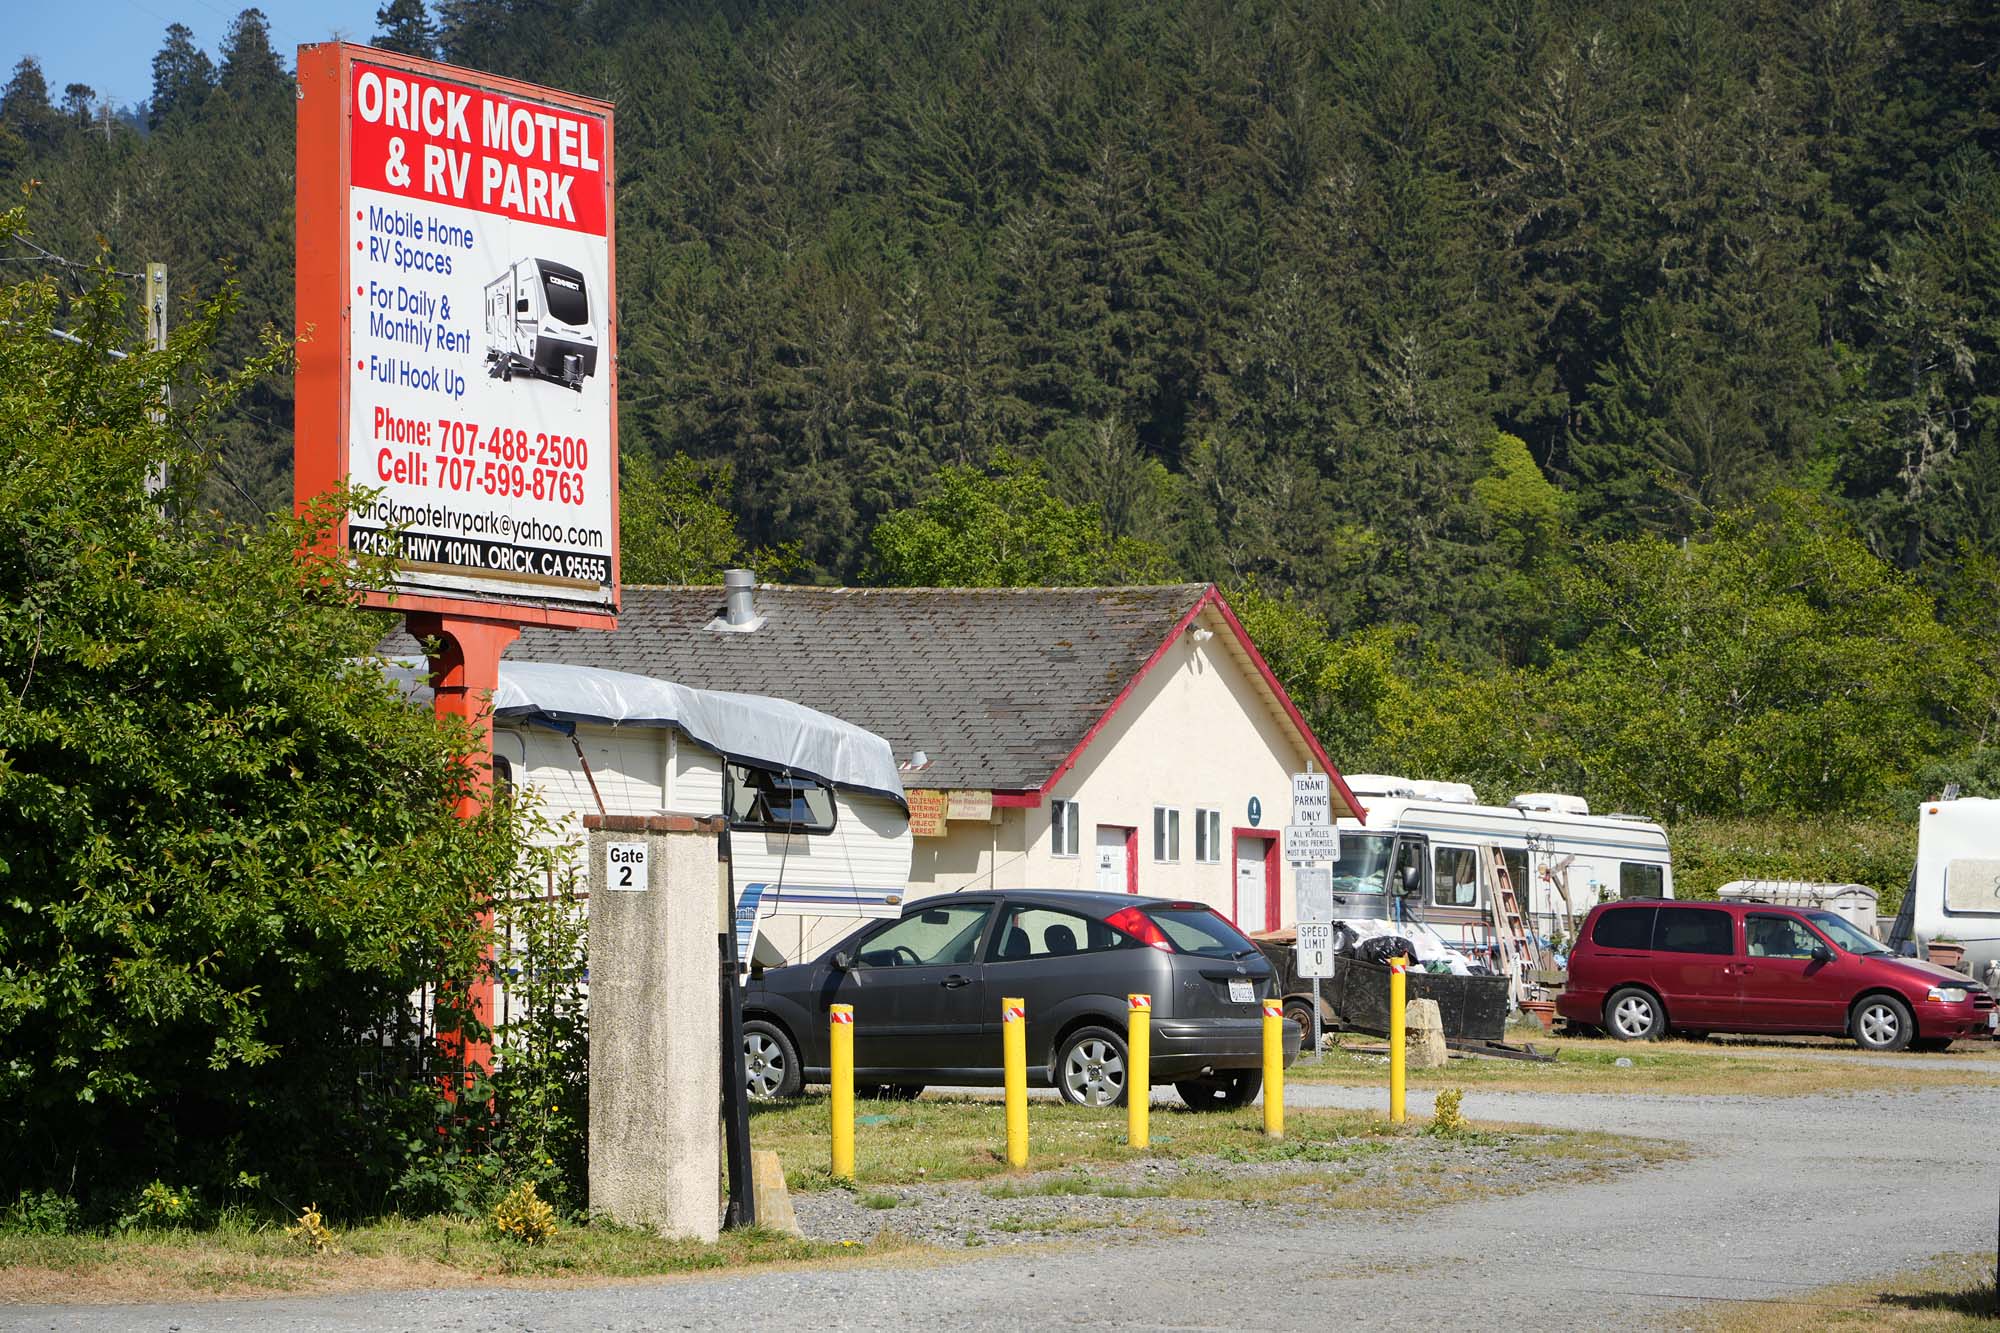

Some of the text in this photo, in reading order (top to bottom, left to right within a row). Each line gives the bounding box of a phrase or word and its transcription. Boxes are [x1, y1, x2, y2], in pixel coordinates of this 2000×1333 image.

[358, 72, 599, 172] ORICK MOTEL
[385, 136, 576, 223] & RV PARK
[369, 205, 474, 249] Mobile Home
[369, 236, 452, 275] RV Spaces
[370, 281, 451, 323] For Daily &
[370, 311, 471, 354] Monthly Rent
[370, 355, 465, 400] Full Hook Up
[375, 406, 588, 471] Phone: 707-488-2500
[377, 448, 584, 505] Cell: 707-599-8763
[408, 536, 442, 562] HWY
[541, 553, 564, 577] CA
[566, 556, 606, 582] 95555
[1295, 796, 1327, 806] PARKING
[1297, 780, 1324, 791] TENANT
[1302, 811, 1321, 821] ONLY
[610, 847, 644, 863] Gate
[619, 866, 632, 886] 2
[1301, 926, 1328, 937] SPEED
[1304, 939, 1326, 949] LIMIT
